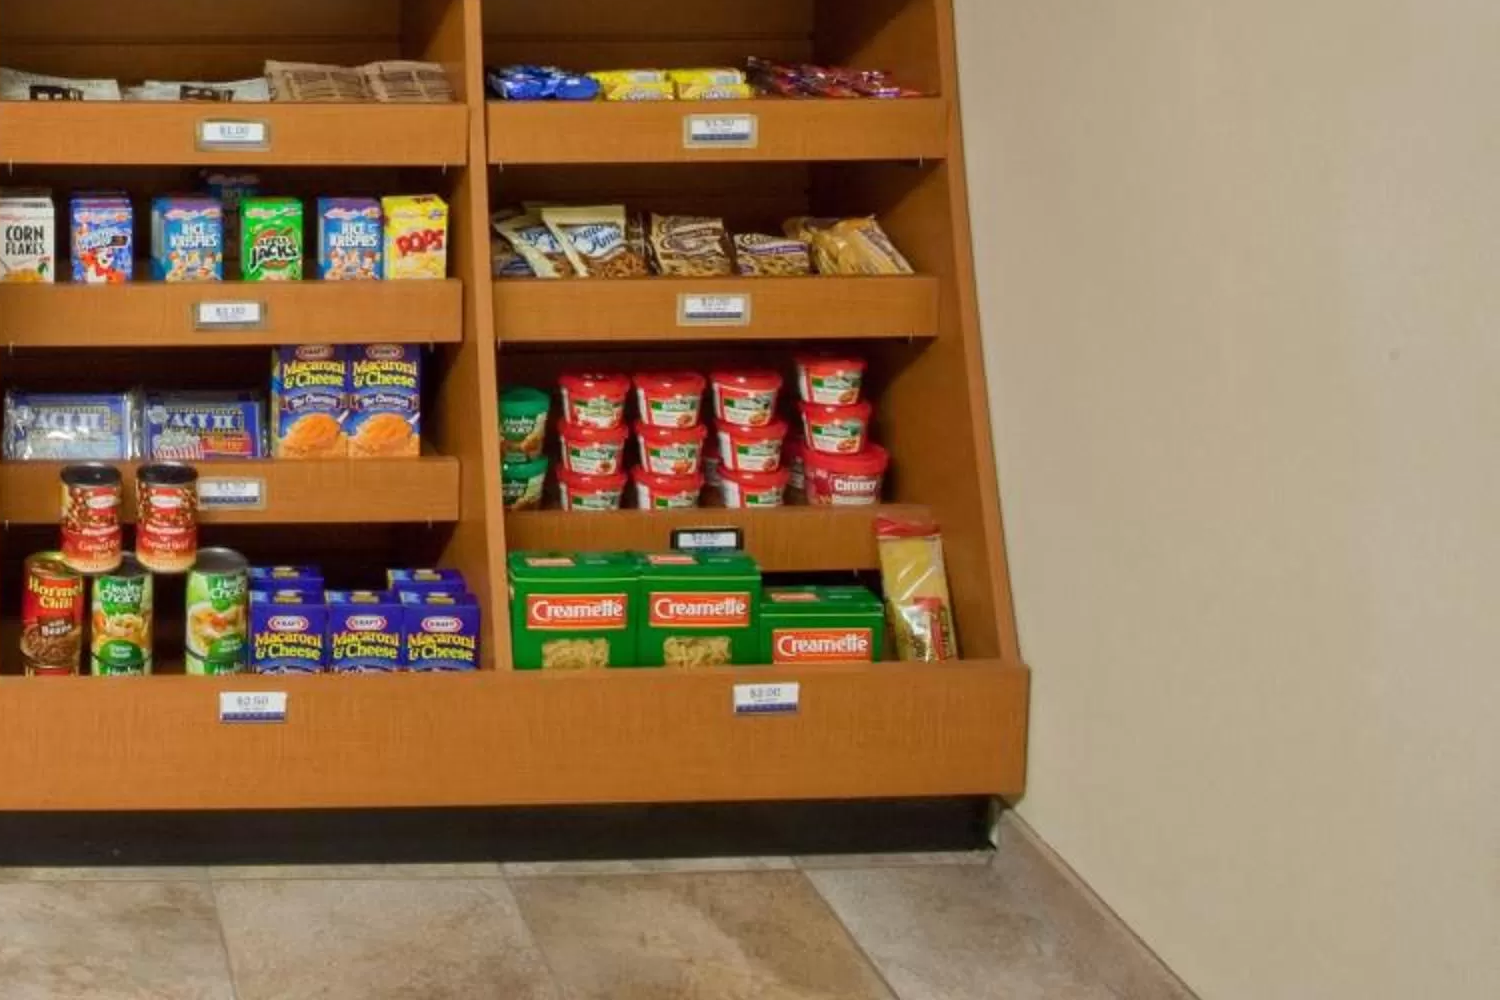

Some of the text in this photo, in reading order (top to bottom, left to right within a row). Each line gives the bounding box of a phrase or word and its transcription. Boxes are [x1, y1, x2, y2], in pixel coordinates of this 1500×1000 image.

[4, 225, 45, 242] CORN
[4, 242, 45, 256] FLAKES
[395, 228, 444, 257] POPS
[250, 243, 298, 271] JACKS
[283, 359, 345, 377] Macaroni
[353, 359, 417, 377] Macaroni
[295, 372, 344, 388] Cheese
[366, 372, 417, 389] Cheese
[33, 412, 75, 429] ACT
[171, 412, 209, 429] ACT
[28, 575, 83, 597] Hormel
[39, 596, 73, 609] Chili
[531, 601, 624, 621] Creamette
[654, 598, 747, 620] Creamette
[41, 623, 73, 638] Beans
[255, 632, 322, 648] Macaroni
[331, 631, 399, 648] Macaroni
[407, 632, 475, 649] Macaroni
[777, 635, 869, 657] Creamette
[267, 643, 321, 660] Cheese
[345, 643, 397, 660] Cheese
[421, 643, 474, 661] Cheese
